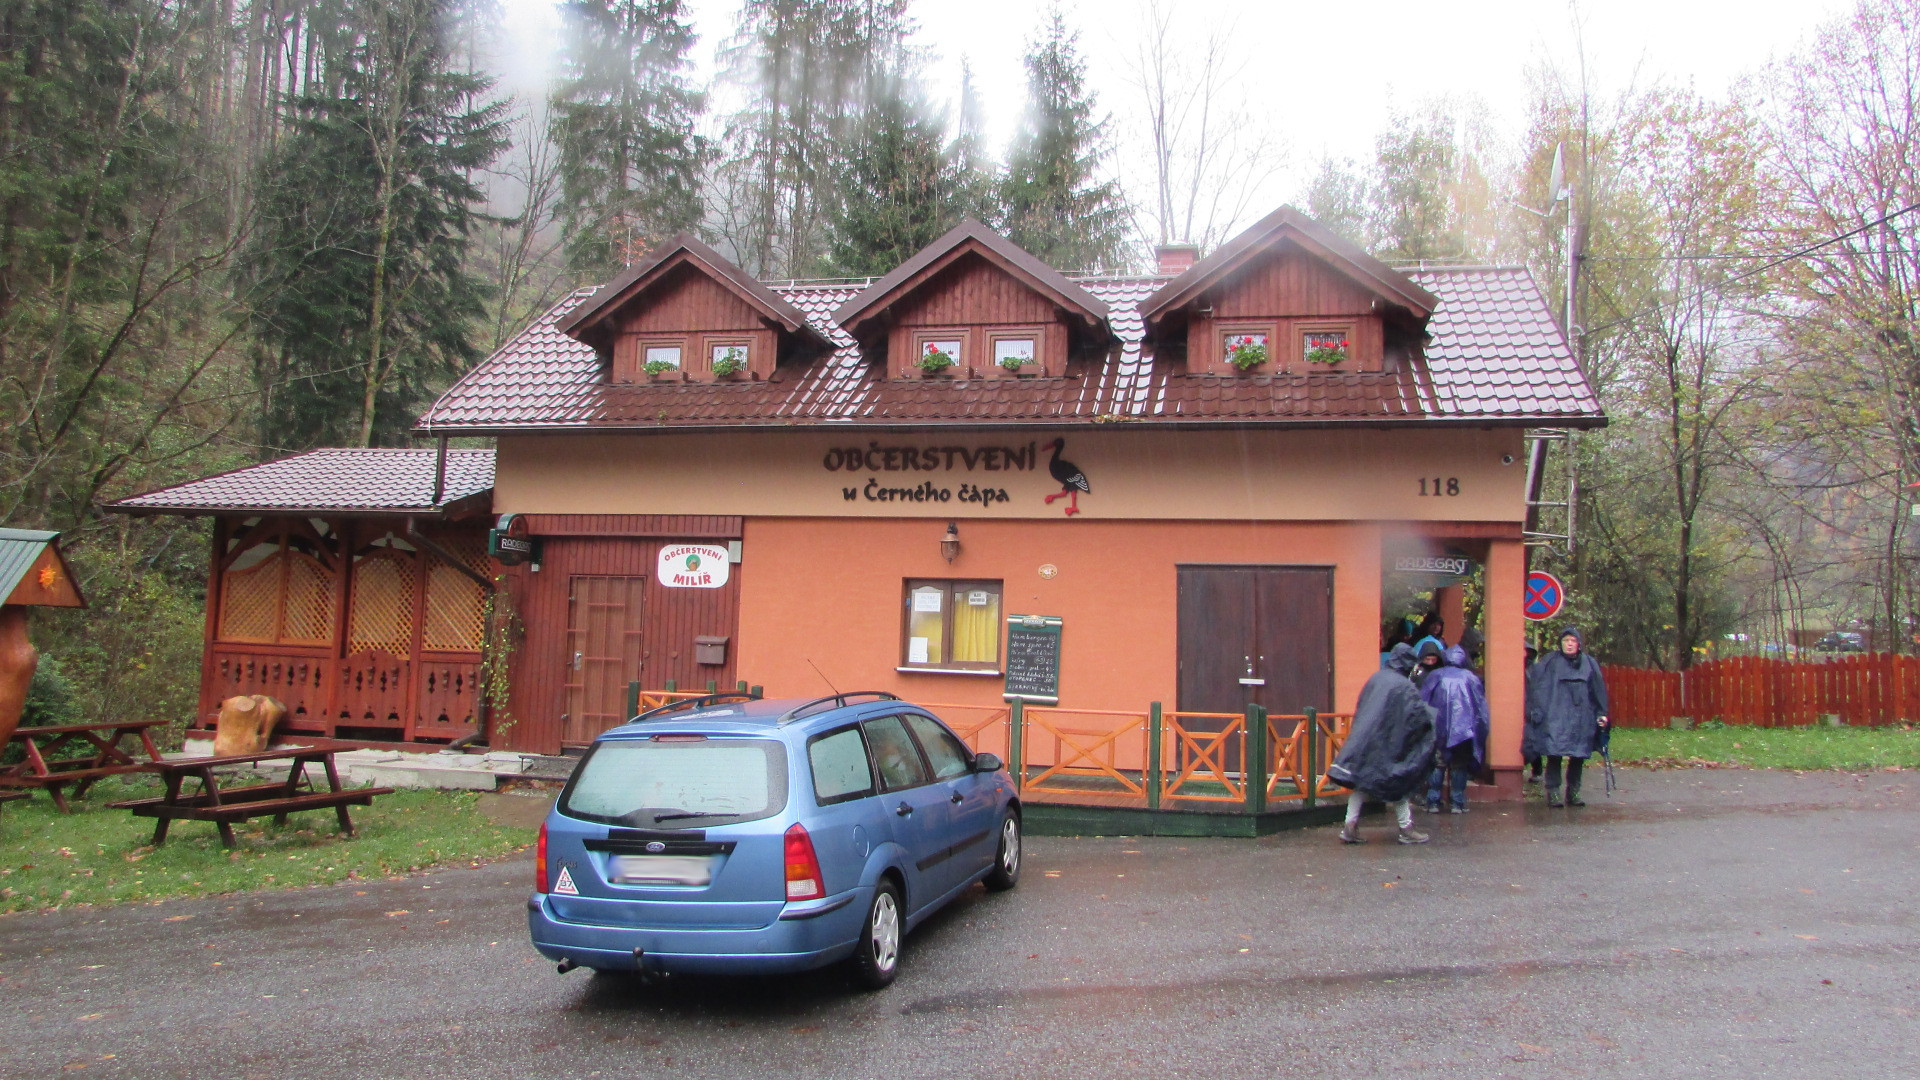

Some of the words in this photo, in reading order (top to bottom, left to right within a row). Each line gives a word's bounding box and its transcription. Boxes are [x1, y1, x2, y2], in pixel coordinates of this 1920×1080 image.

[823, 442, 1036, 471] OBČERSTVENÍ
[842, 487, 857, 500] u
[864, 478, 951, 501] Černého
[957, 483, 1010, 507] čápa
[1418, 477, 1460, 496] 118
[1395, 557, 1468, 574] RADEGAST
[673, 571, 711, 585] MILÍŘ
